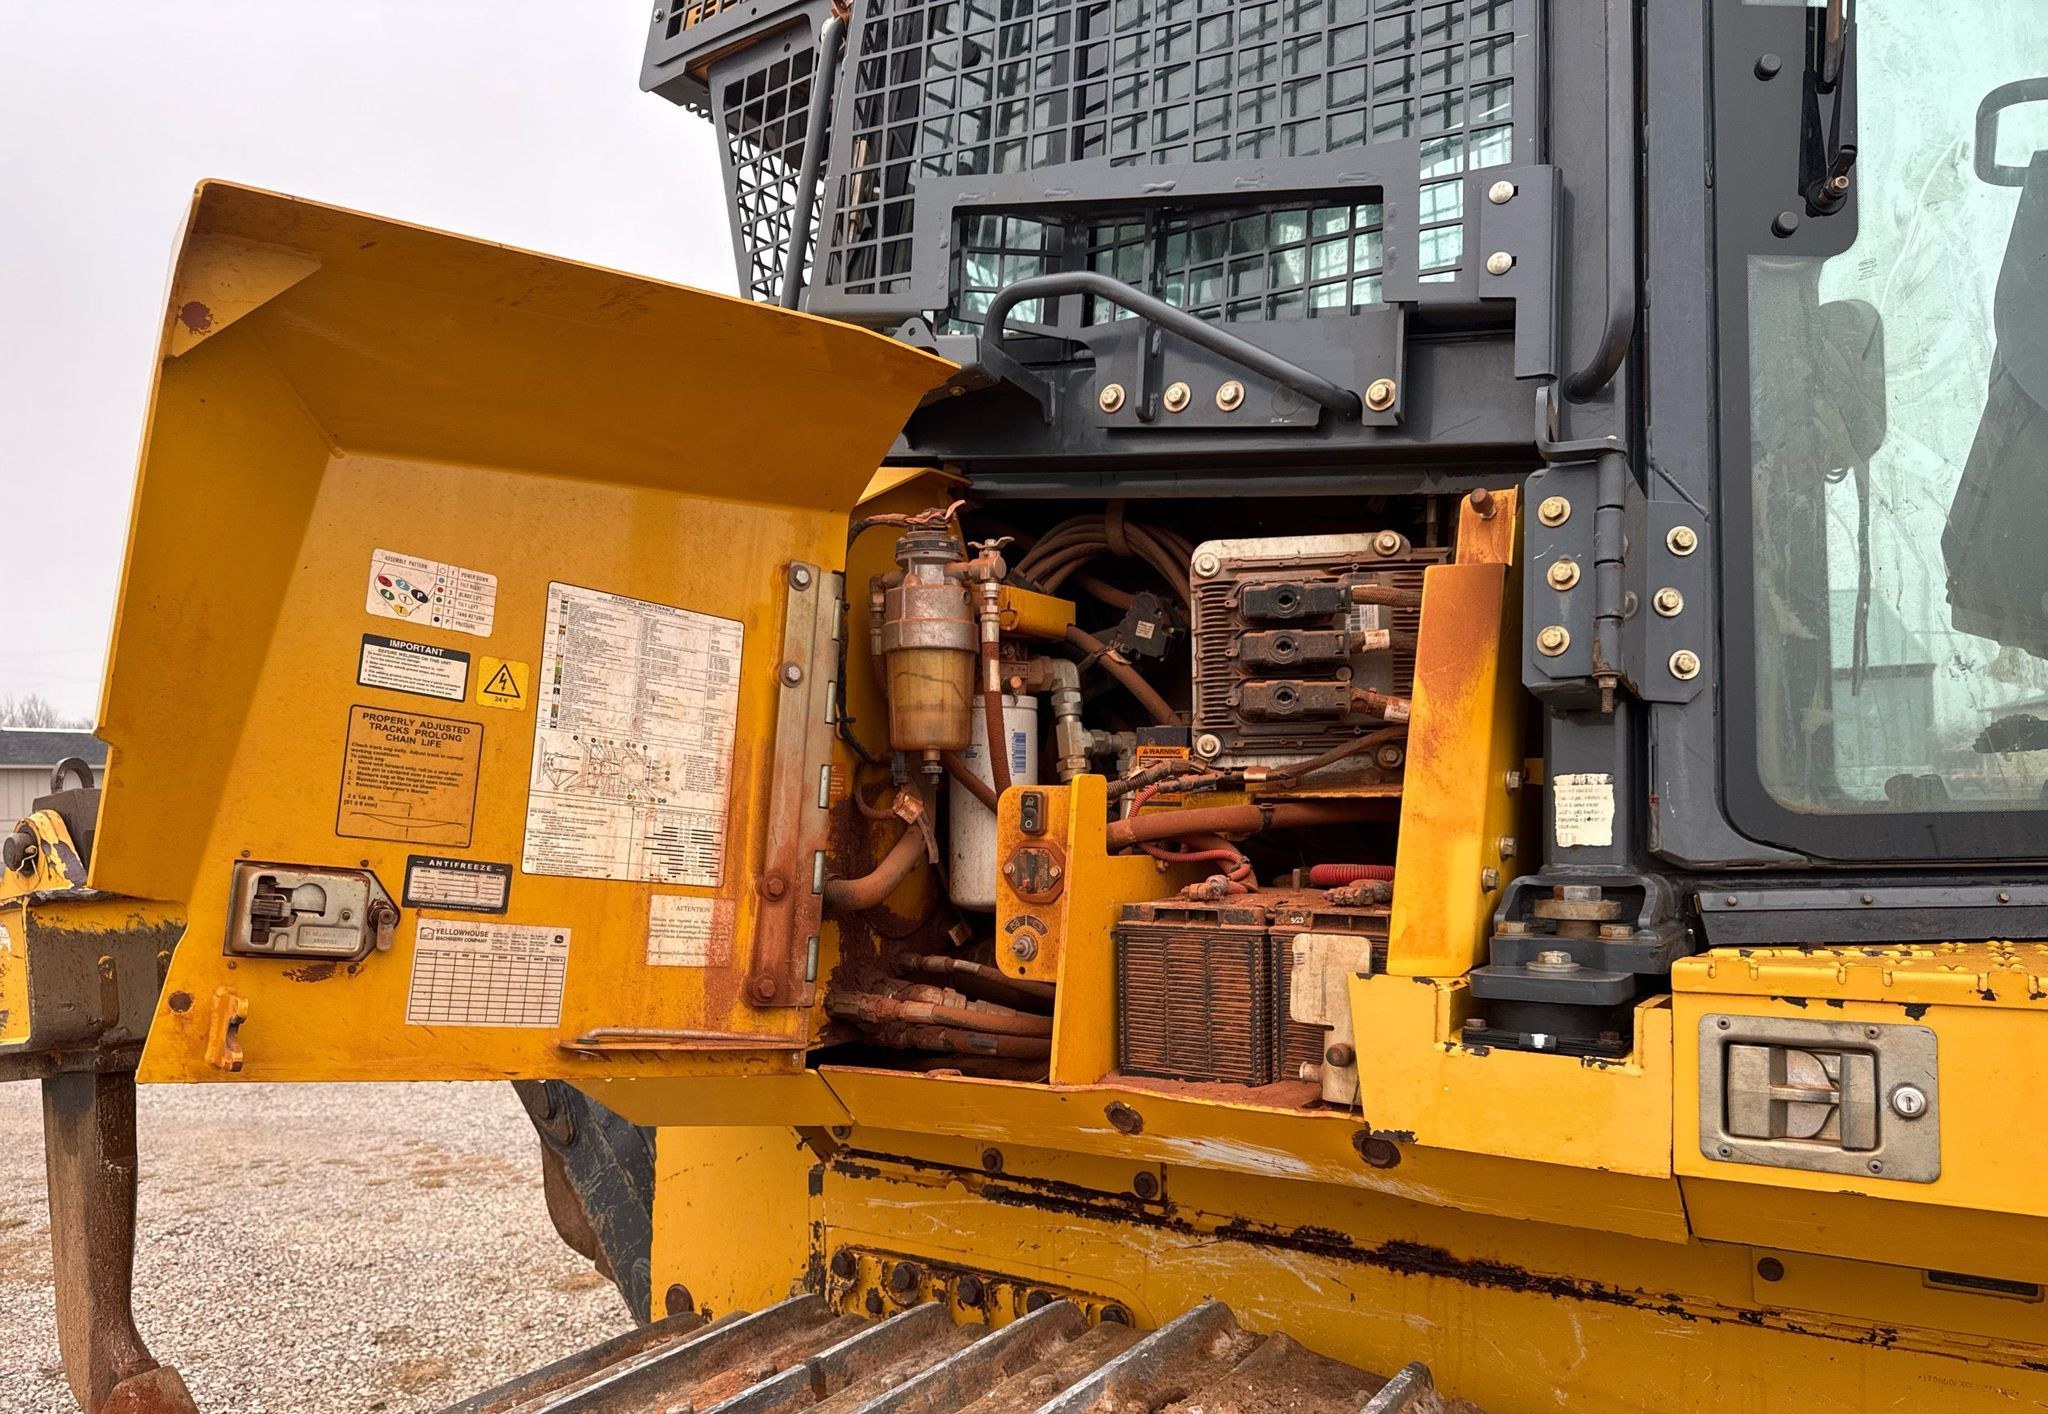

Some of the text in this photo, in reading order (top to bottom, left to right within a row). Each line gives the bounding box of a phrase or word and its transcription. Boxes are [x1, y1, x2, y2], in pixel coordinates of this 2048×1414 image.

[384, 555, 427, 569] ASSEMBLY PATTERN
[389, 639, 444, 656] IMPORTANT
[362, 712, 470, 734] PROPERLY ADJUSTED
[369, 722, 462, 741] TRACKS PROLONG
[385, 733, 442, 748] CHAIN LIFE
[428, 859, 492, 871] ANTIFREEZE
[435, 927, 489, 937] YELLOWHOUSE
